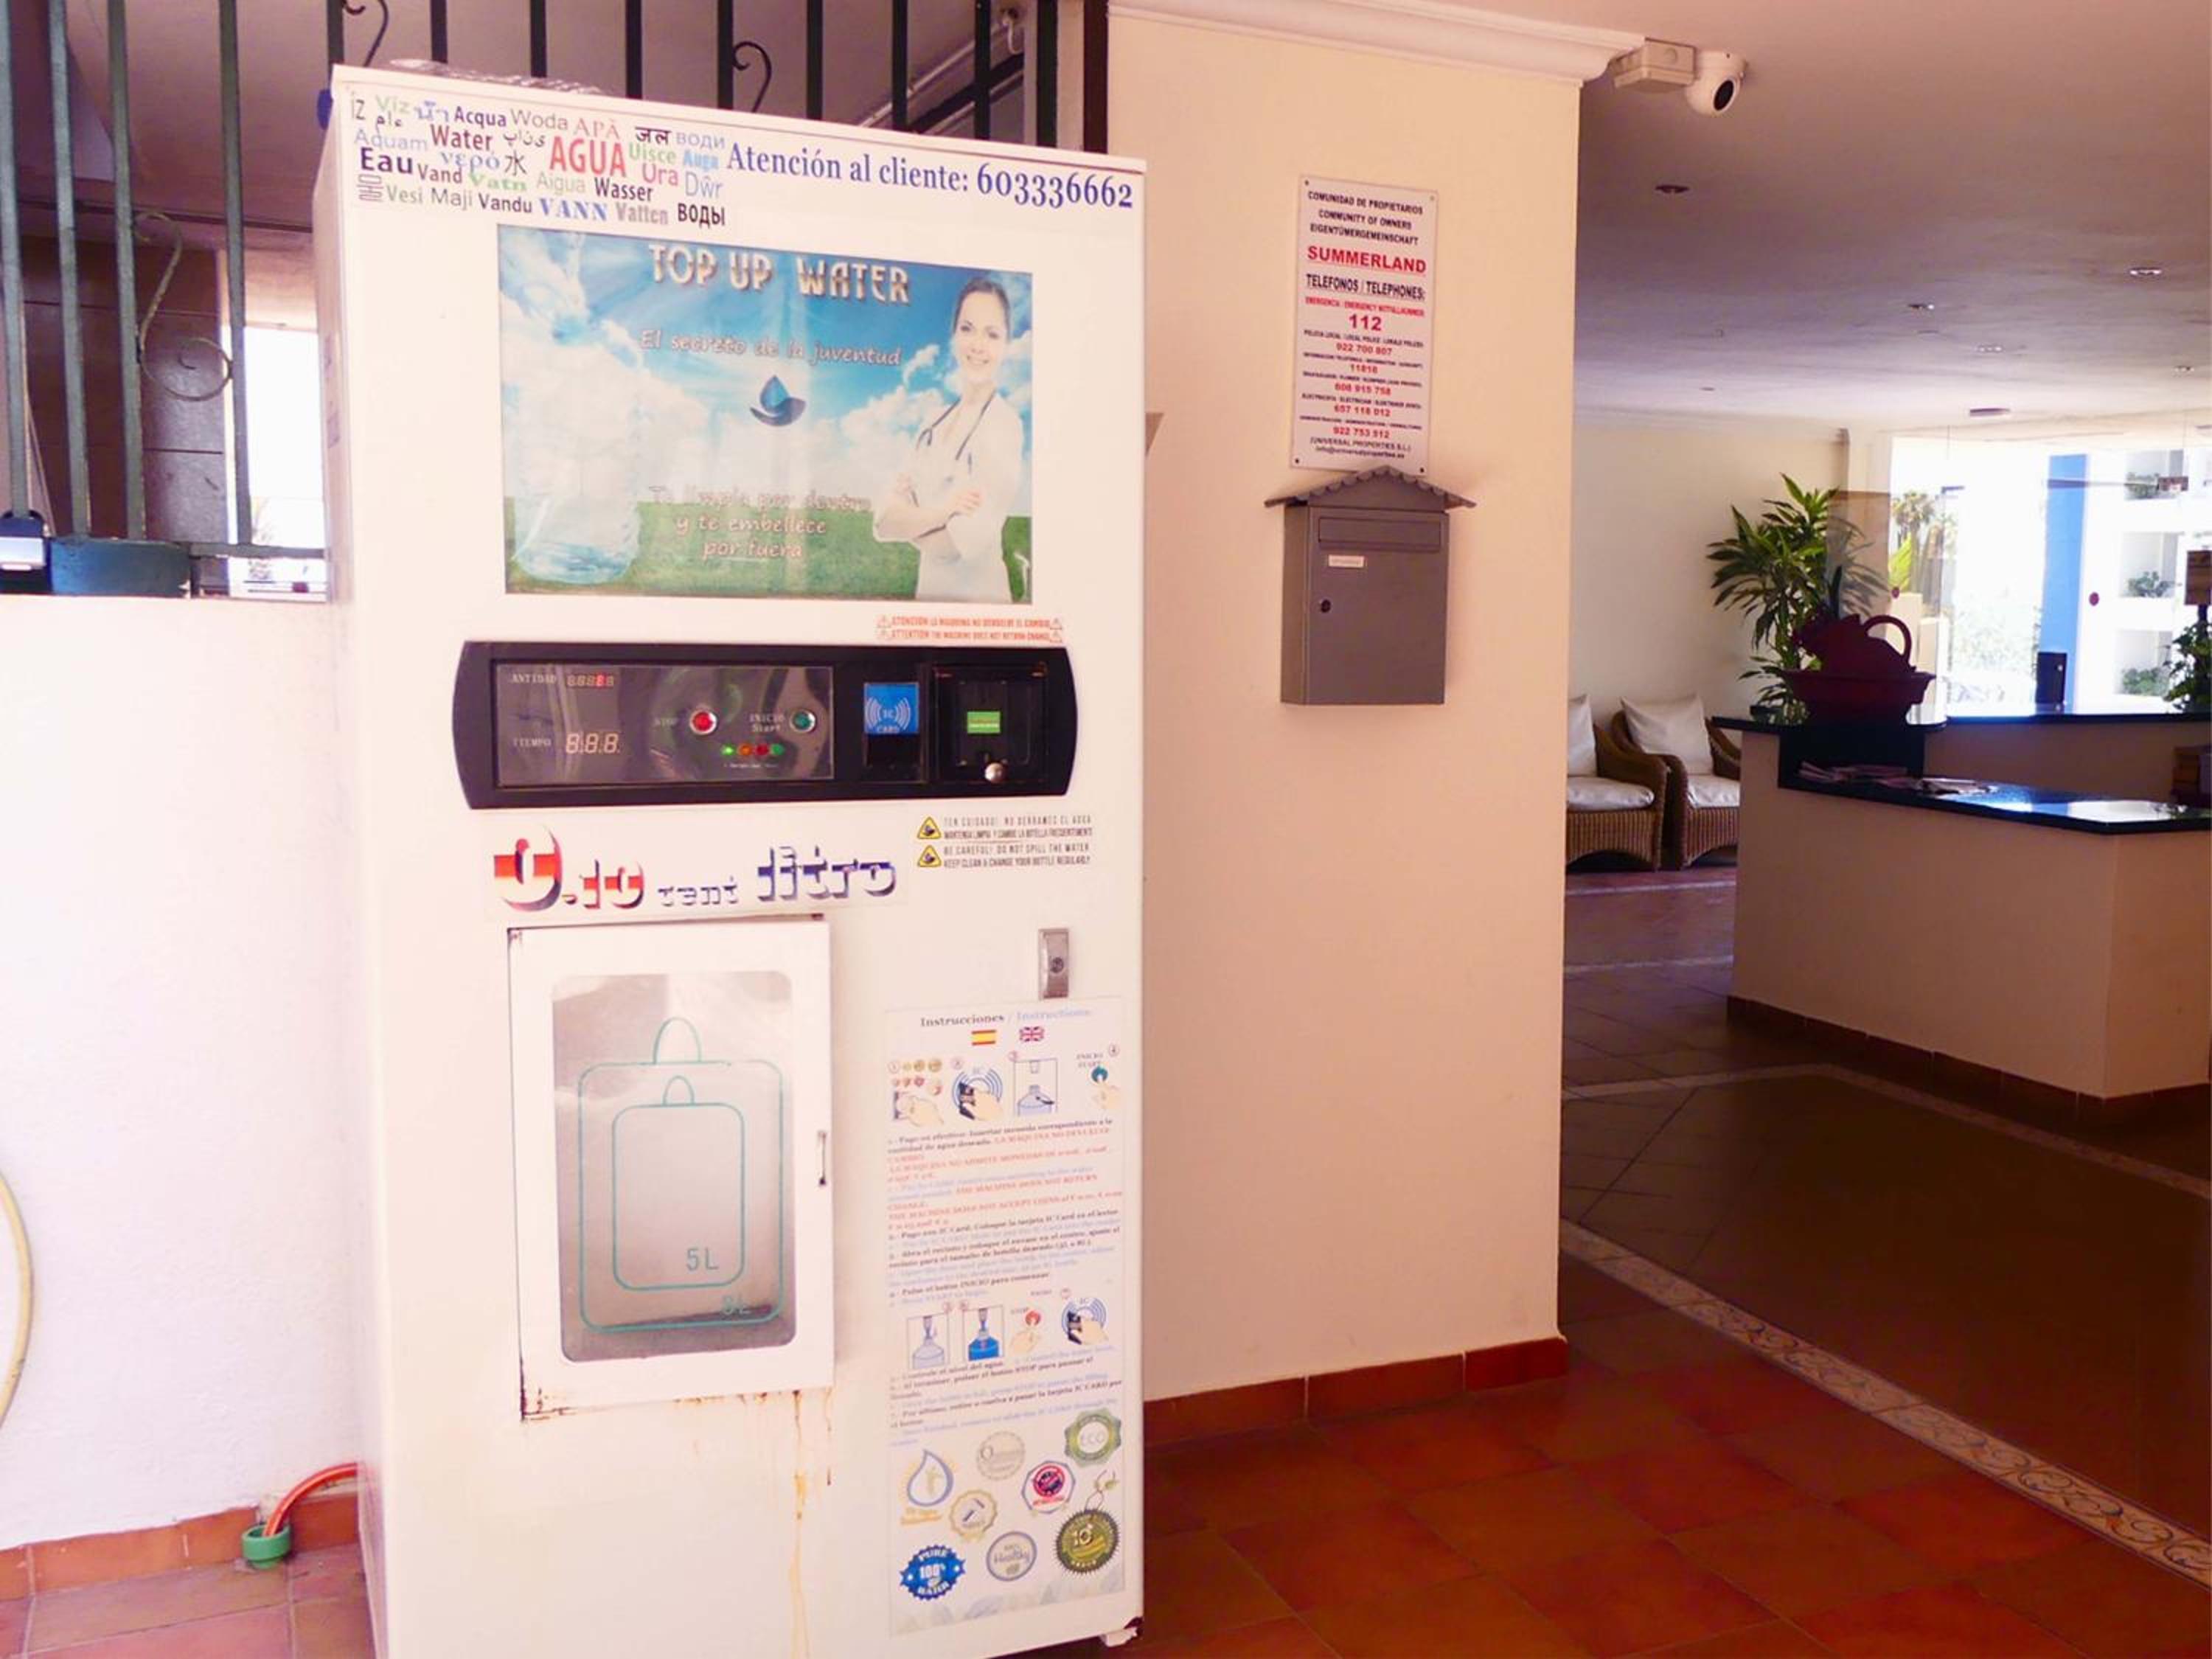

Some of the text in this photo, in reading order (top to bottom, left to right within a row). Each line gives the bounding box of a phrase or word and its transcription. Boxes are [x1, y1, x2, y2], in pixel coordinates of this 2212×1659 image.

[454, 106, 507, 129] Acqua
[510, 108, 568, 131] Woda
[354, 128, 429, 152] Aquam
[429, 123, 494, 151] Water
[634, 125, 672, 146] जल
[360, 147, 414, 175] Eau
[504, 149, 528, 177] 水
[549, 136, 627, 178] AGUA
[629, 142, 676, 165] Uisce
[417, 162, 463, 184] Vand
[537, 171, 587, 196] Aigua
[642, 162, 679, 186] Ura
[725, 142, 1133, 210] Atención al cliente: 603336662
[386, 184, 423, 204] Vesi
[431, 187, 473, 212] Maji
[594, 176, 654, 202] Wasser
[478, 193, 533, 214] Vandu
[539, 197, 608, 222] VANN
[616, 201, 669, 225] Vatten
[1307, 190, 1424, 215] COMUNIDAD DE PROPIETARIOS
[1318, 209, 1412, 230] COMMUNITY OF OWNERS
[1307, 245, 1427, 274] SUMMERLAND
[647, 242, 913, 305] TOP UP WATER
[1306, 274, 1425, 301] TELEFONOS TELEPHONES:
[1349, 313, 1382, 331] 112
[640, 329, 903, 367] El secreto de la juventud
[1336, 342, 1354, 352] 922
[1357, 344, 1374, 354] 700
[728, 514, 827, 535] embellece
[701, 540, 740, 561] por
[507, 673, 557, 684] ANTIDAD
[921, 1013, 1006, 1028] Instrucciones
[686, 1246, 720, 1272] 5L
